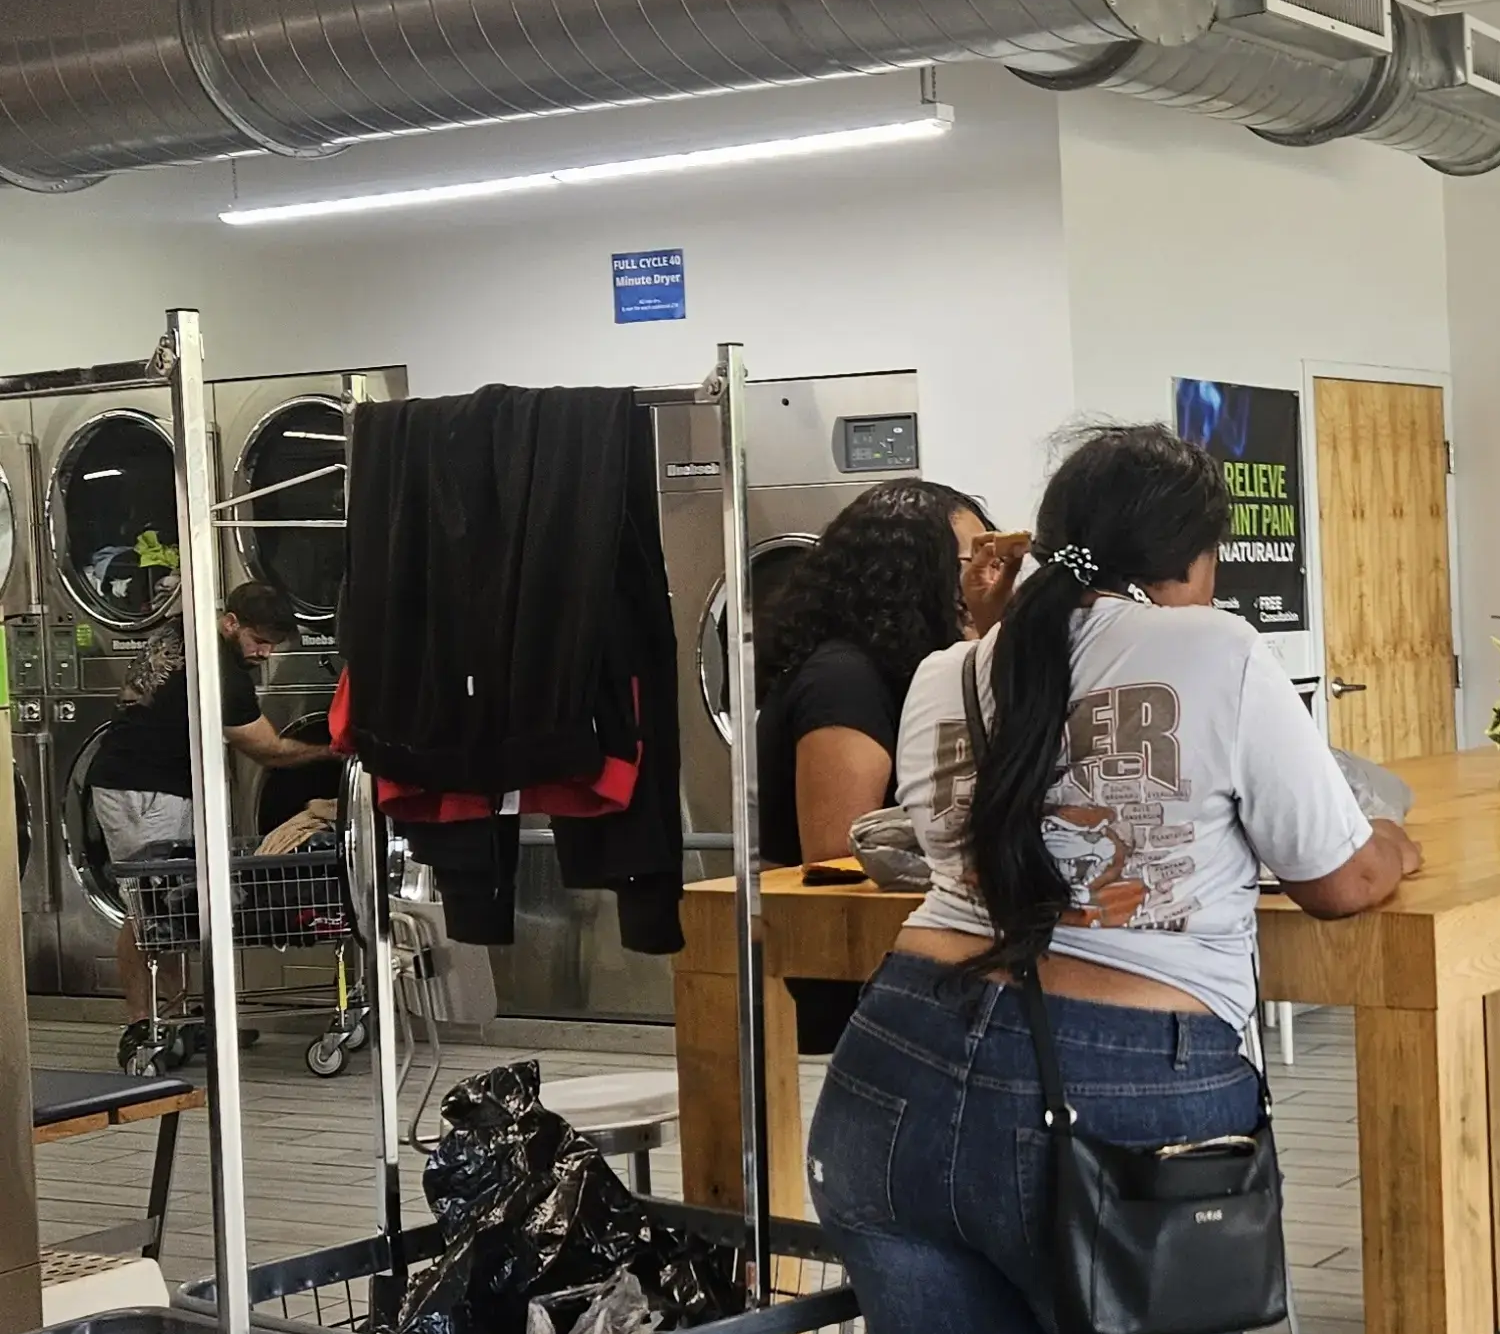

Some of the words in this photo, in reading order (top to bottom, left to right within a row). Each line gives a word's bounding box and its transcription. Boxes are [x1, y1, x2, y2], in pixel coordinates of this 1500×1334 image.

[613, 259, 638, 271] FULL
[639, 255, 669, 269] CYCLE
[669, 255, 681, 266] 40
[615, 275, 652, 287] Minute
[653, 273, 681, 286] Dryer
[1223, 461, 1287, 499] RELIEVE
[1261, 504, 1295, 537] PAIN
[1218, 540, 1296, 563] NATURALLY
